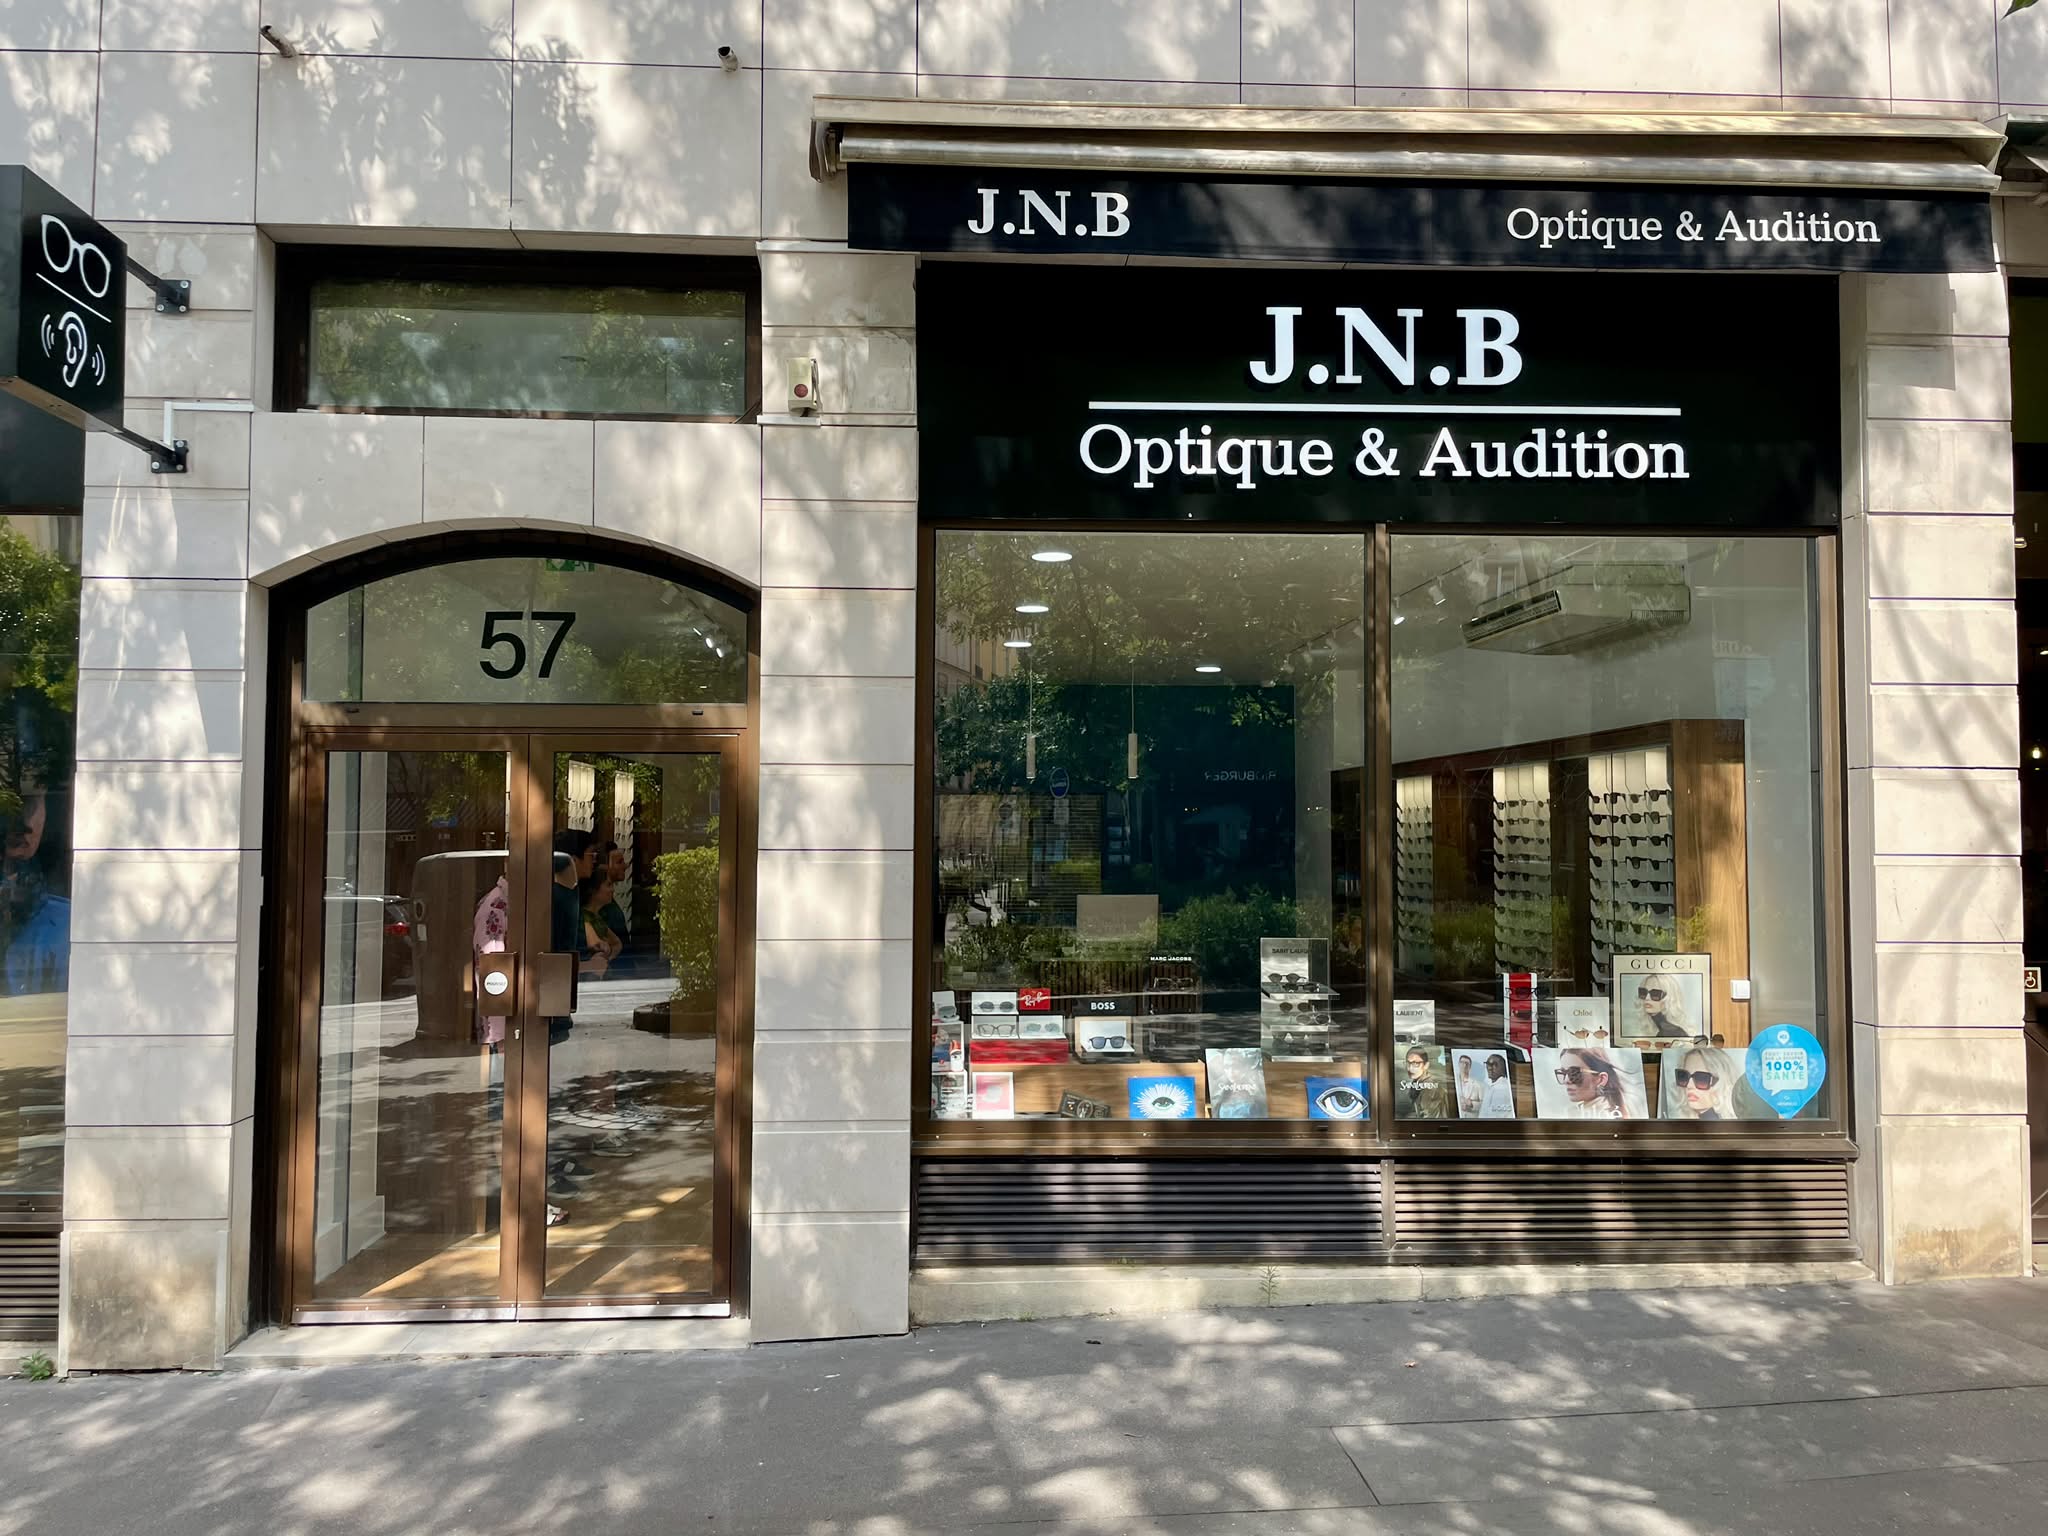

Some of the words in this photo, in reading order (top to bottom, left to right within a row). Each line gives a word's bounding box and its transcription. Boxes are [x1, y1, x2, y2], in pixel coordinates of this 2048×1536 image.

[967, 188, 1130, 237] J.N.B
[1507, 207, 1663, 249] Optique
[1676, 210, 1704, 242] &
[1715, 210, 1881, 243] Audition
[1249, 306, 1523, 386] J.N.B
[1079, 423, 1334, 489] Optique
[1355, 427, 1401, 476] &
[1418, 426, 1690, 479] Audition
[479, 611, 577, 680] 57
[1630, 959, 1693, 970] GUCCI
[1090, 1002, 1116, 1010] BOSS
[1765, 1060, 1804, 1071] 100%
